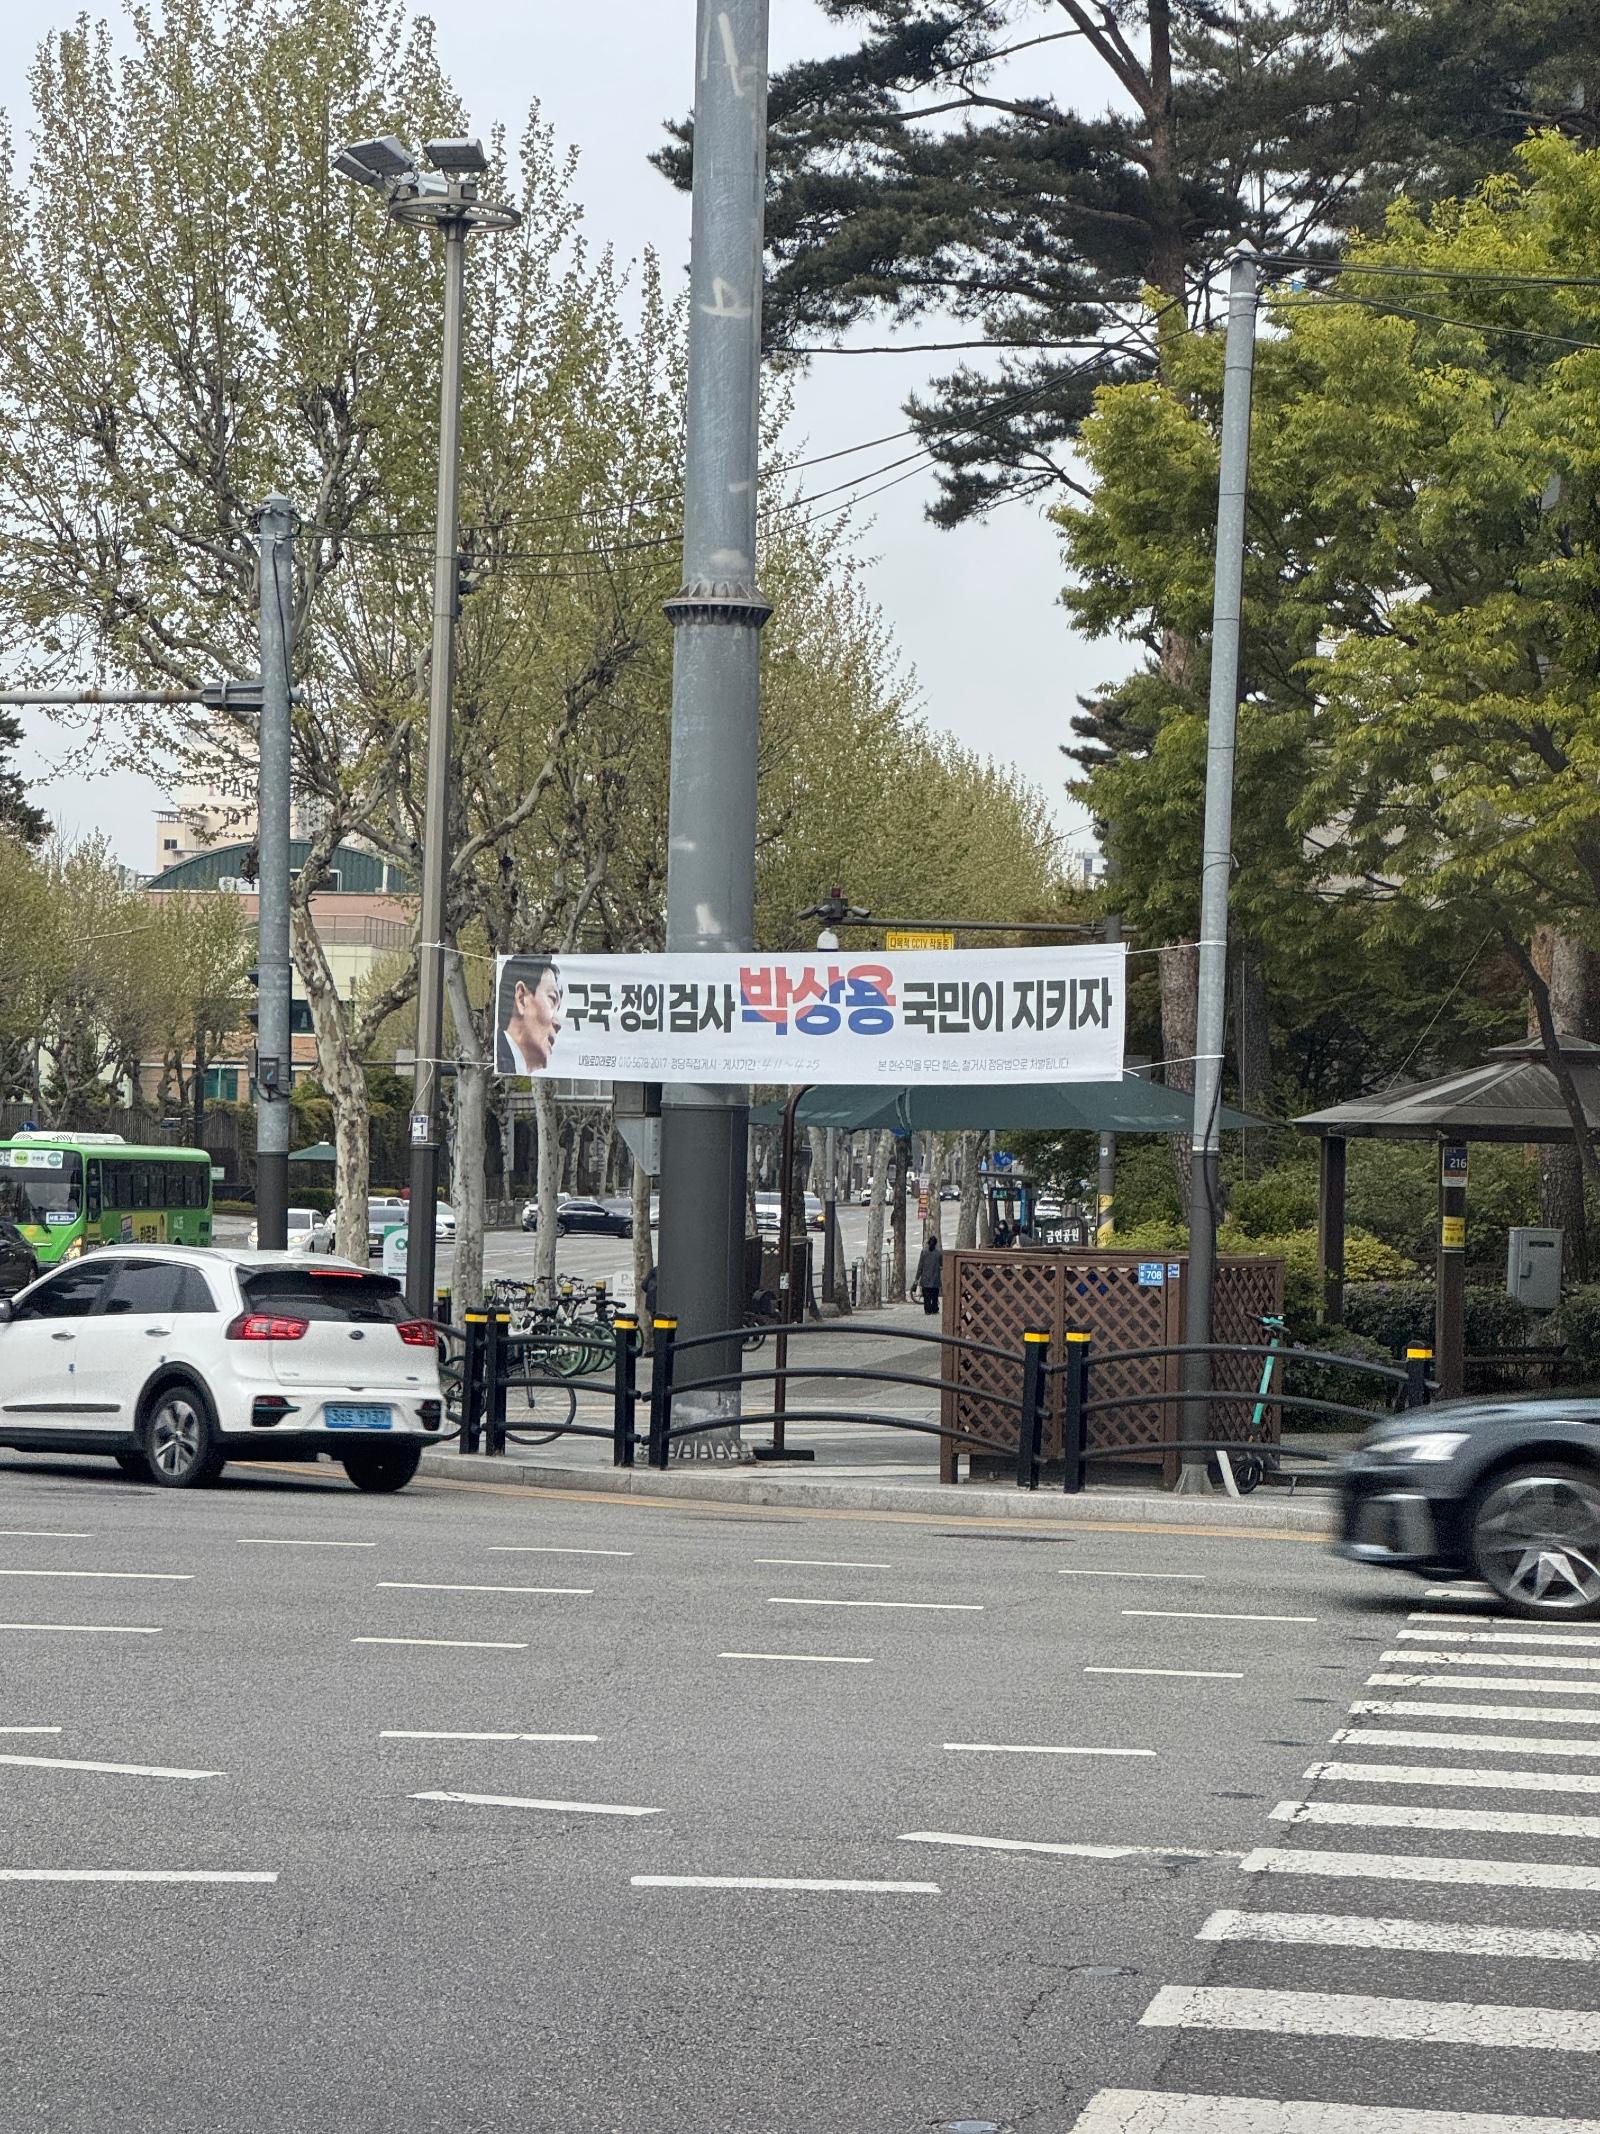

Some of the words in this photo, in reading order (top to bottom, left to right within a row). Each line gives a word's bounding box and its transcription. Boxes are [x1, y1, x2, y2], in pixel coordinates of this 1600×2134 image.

[890, 937, 910, 949] 다목적
[911, 938, 928, 949] CCTV
[929, 938, 950, 950] 작동중
[669, 983, 736, 1033] 검사
[739, 964, 897, 1036] 박상용
[902, 980, 1004, 1034] 국민이
[1011, 976, 1112, 1032] 지키자
[878, 1060, 887, 1072] 본
[888, 1059, 922, 1072] 현수막을
[923, 1059, 941, 1072] 무단
[1449, 1158, 1467, 1169] 216
[1045, 1227, 1080, 1244] 금연공원
[1146, 1270, 1162, 1280] 708
